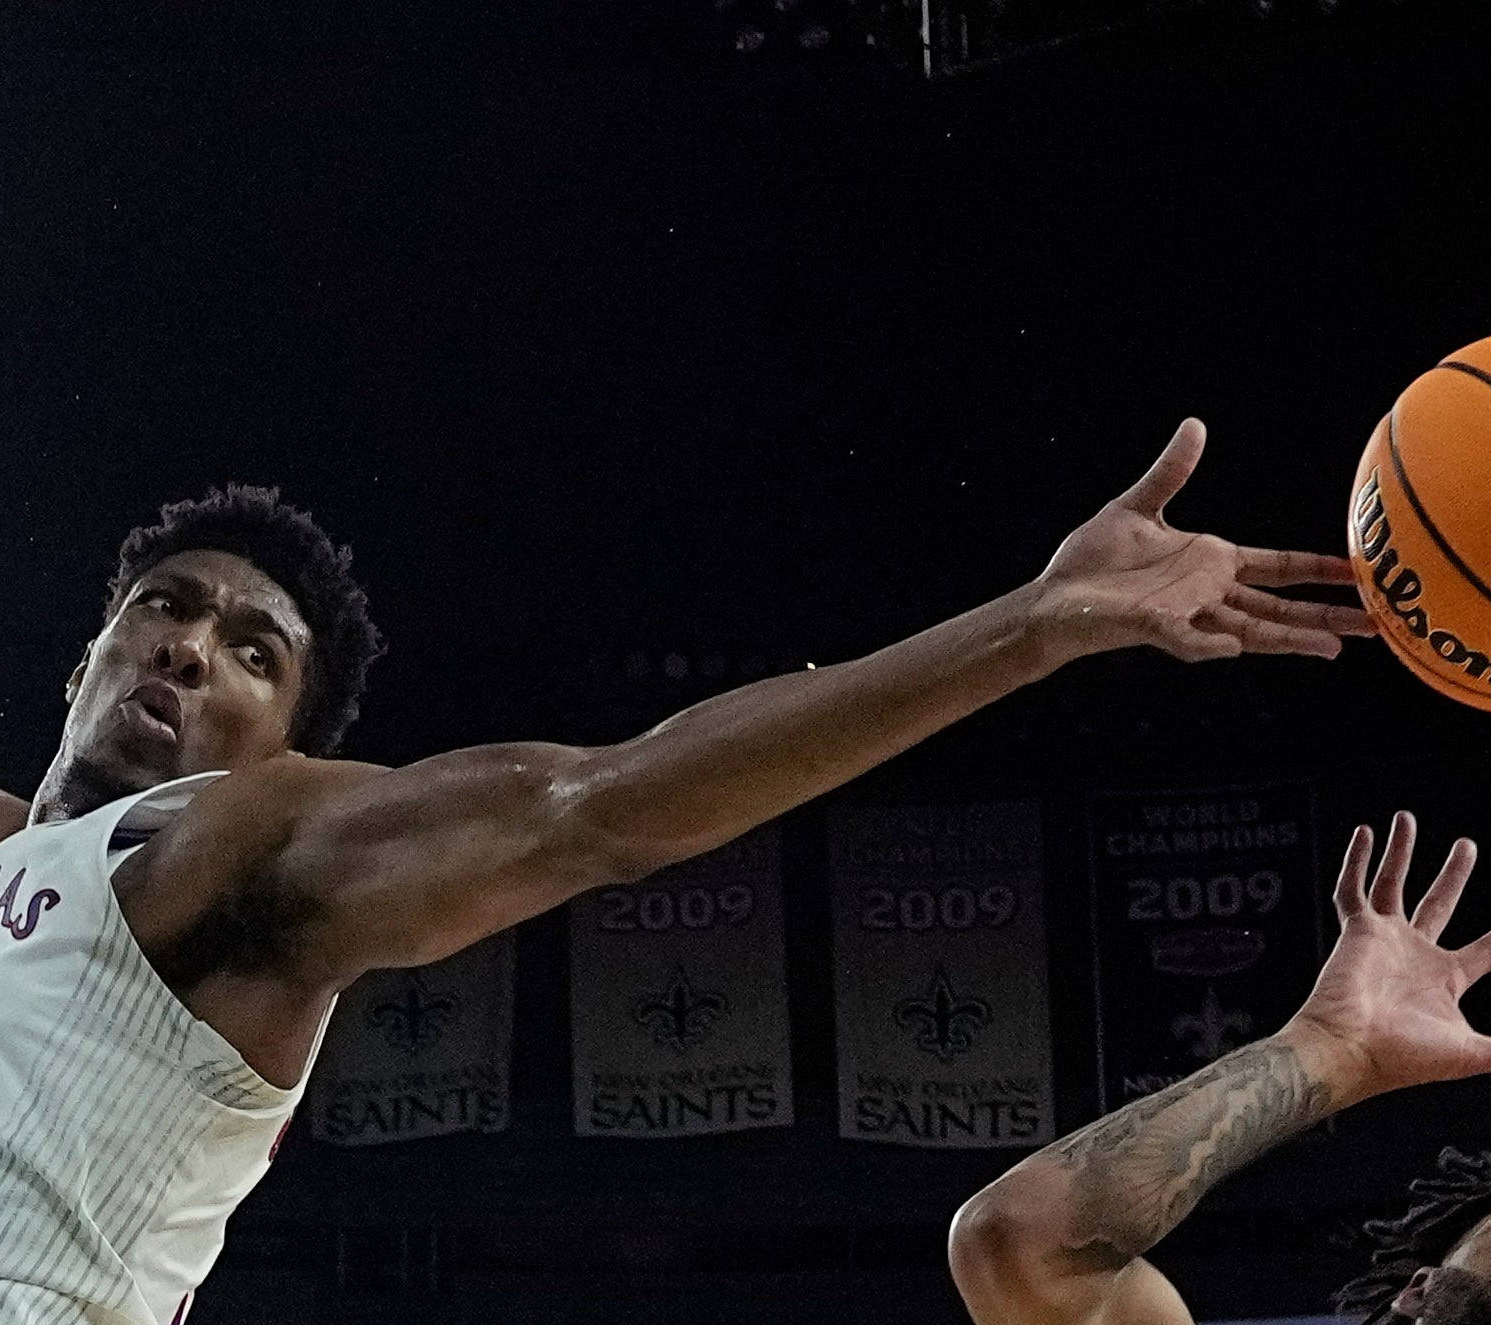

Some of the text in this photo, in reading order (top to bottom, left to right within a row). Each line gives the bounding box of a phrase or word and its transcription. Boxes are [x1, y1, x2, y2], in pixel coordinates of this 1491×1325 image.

[599, 884, 755, 931] 2009
[861, 884, 1017, 931] 2009
[1127, 870, 1283, 920] 2009
[591, 1084, 777, 1130] SAINTS
[855, 1097, 1040, 1140] SAINTS
